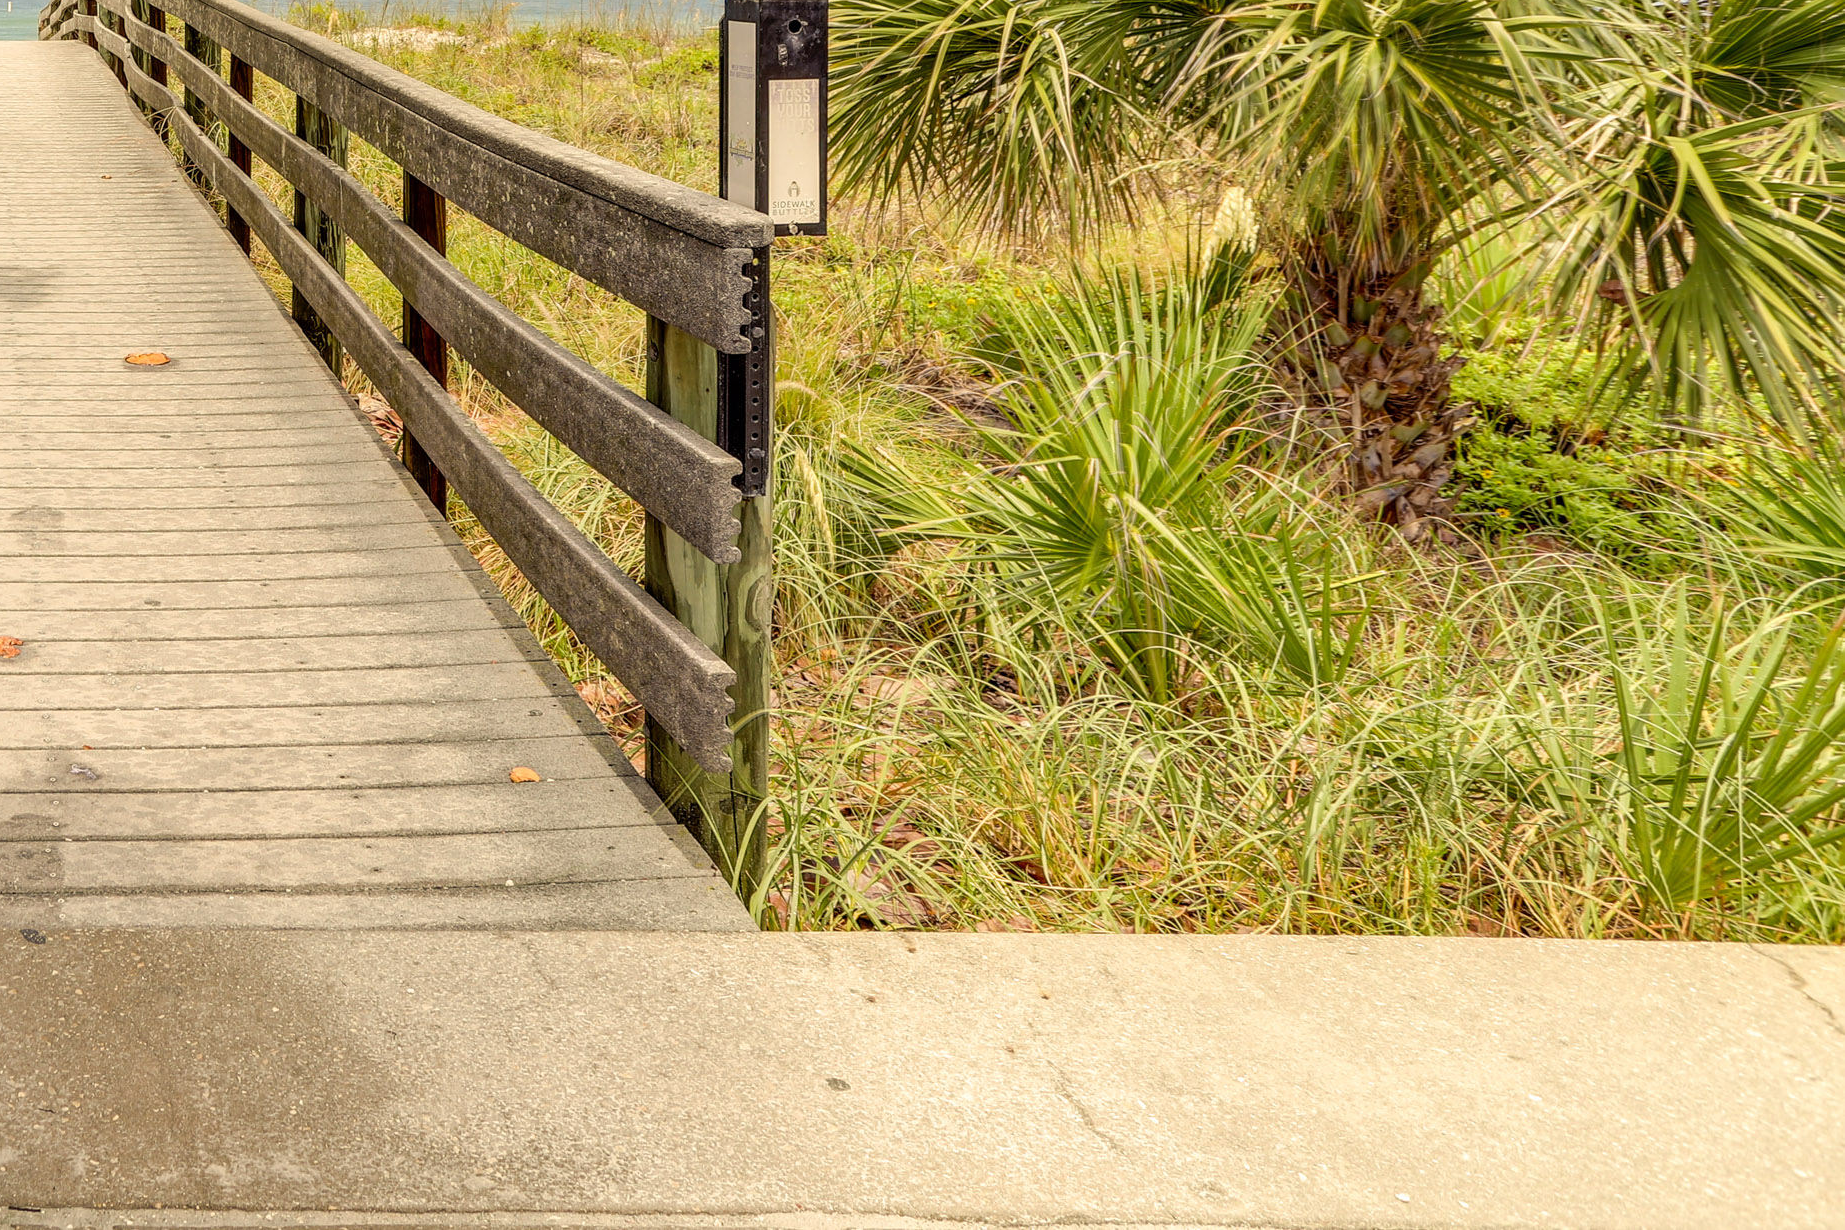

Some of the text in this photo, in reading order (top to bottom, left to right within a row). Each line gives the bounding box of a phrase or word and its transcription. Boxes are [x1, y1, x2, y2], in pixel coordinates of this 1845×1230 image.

[777, 88, 811, 103] TOSS
[777, 103, 811, 118] YOUR
[772, 200, 815, 209] SIDEWALK
